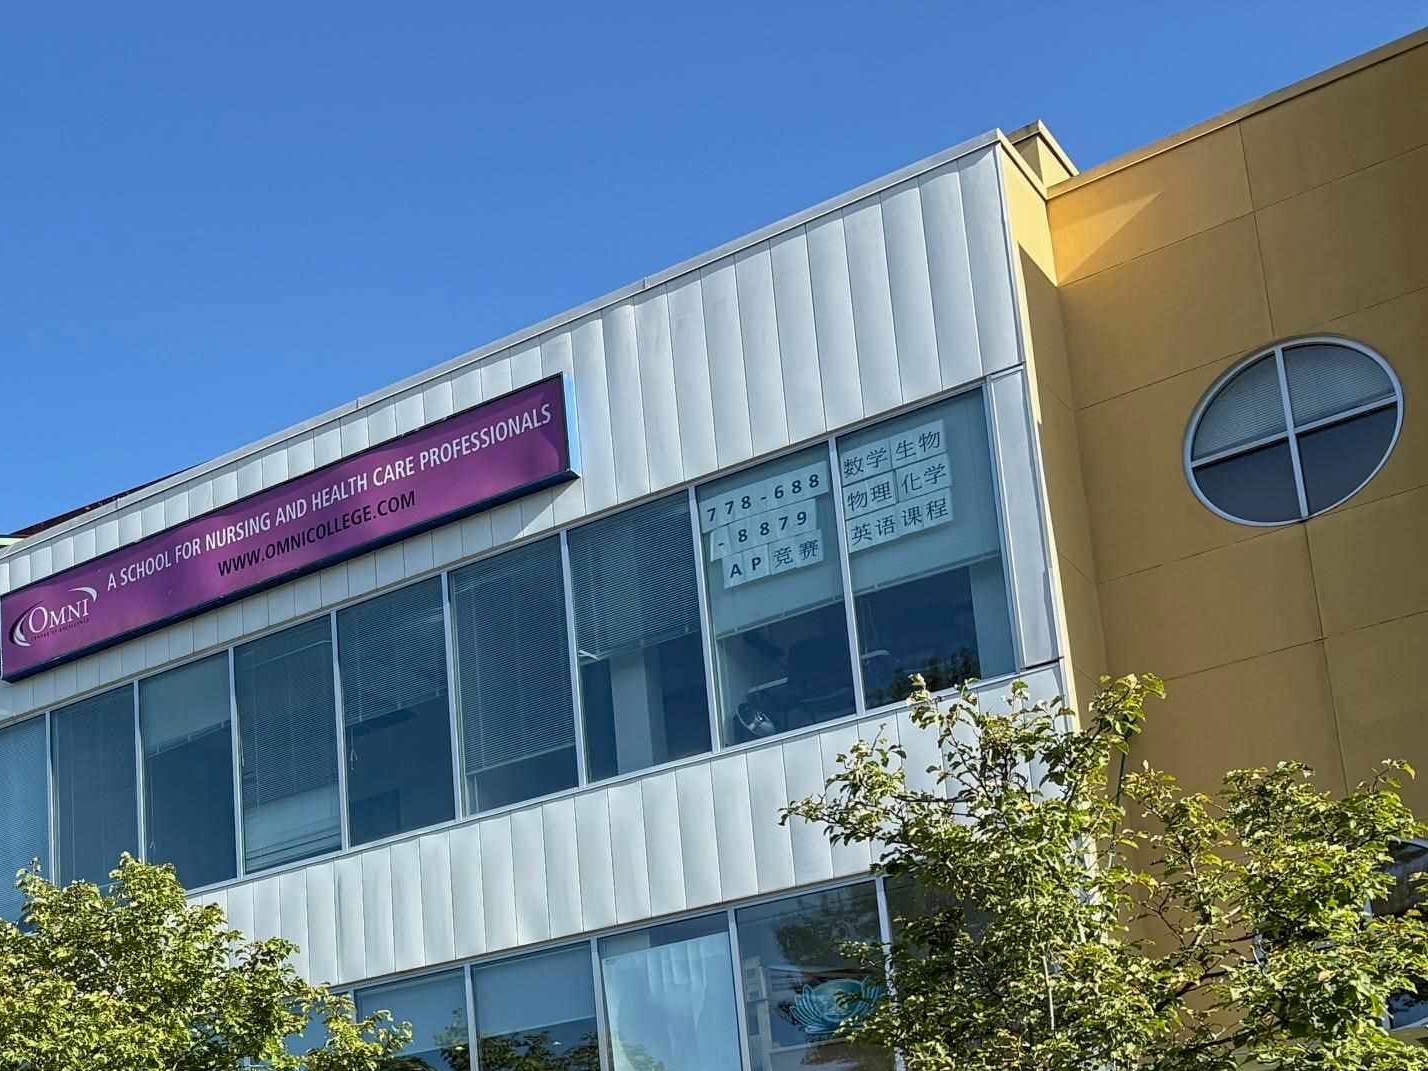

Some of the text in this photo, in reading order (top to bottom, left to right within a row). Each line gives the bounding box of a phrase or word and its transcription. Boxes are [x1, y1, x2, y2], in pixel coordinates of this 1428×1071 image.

[107, 403, 553, 592] A SCHOOL FOR NURSING AND HEALTH CARE PROFESSIONALS
[706, 473, 821, 522] 778-688
[850, 499, 950, 547] 英语课程
[218, 490, 417, 577] WWW.OMNICOLLEGE.COM
